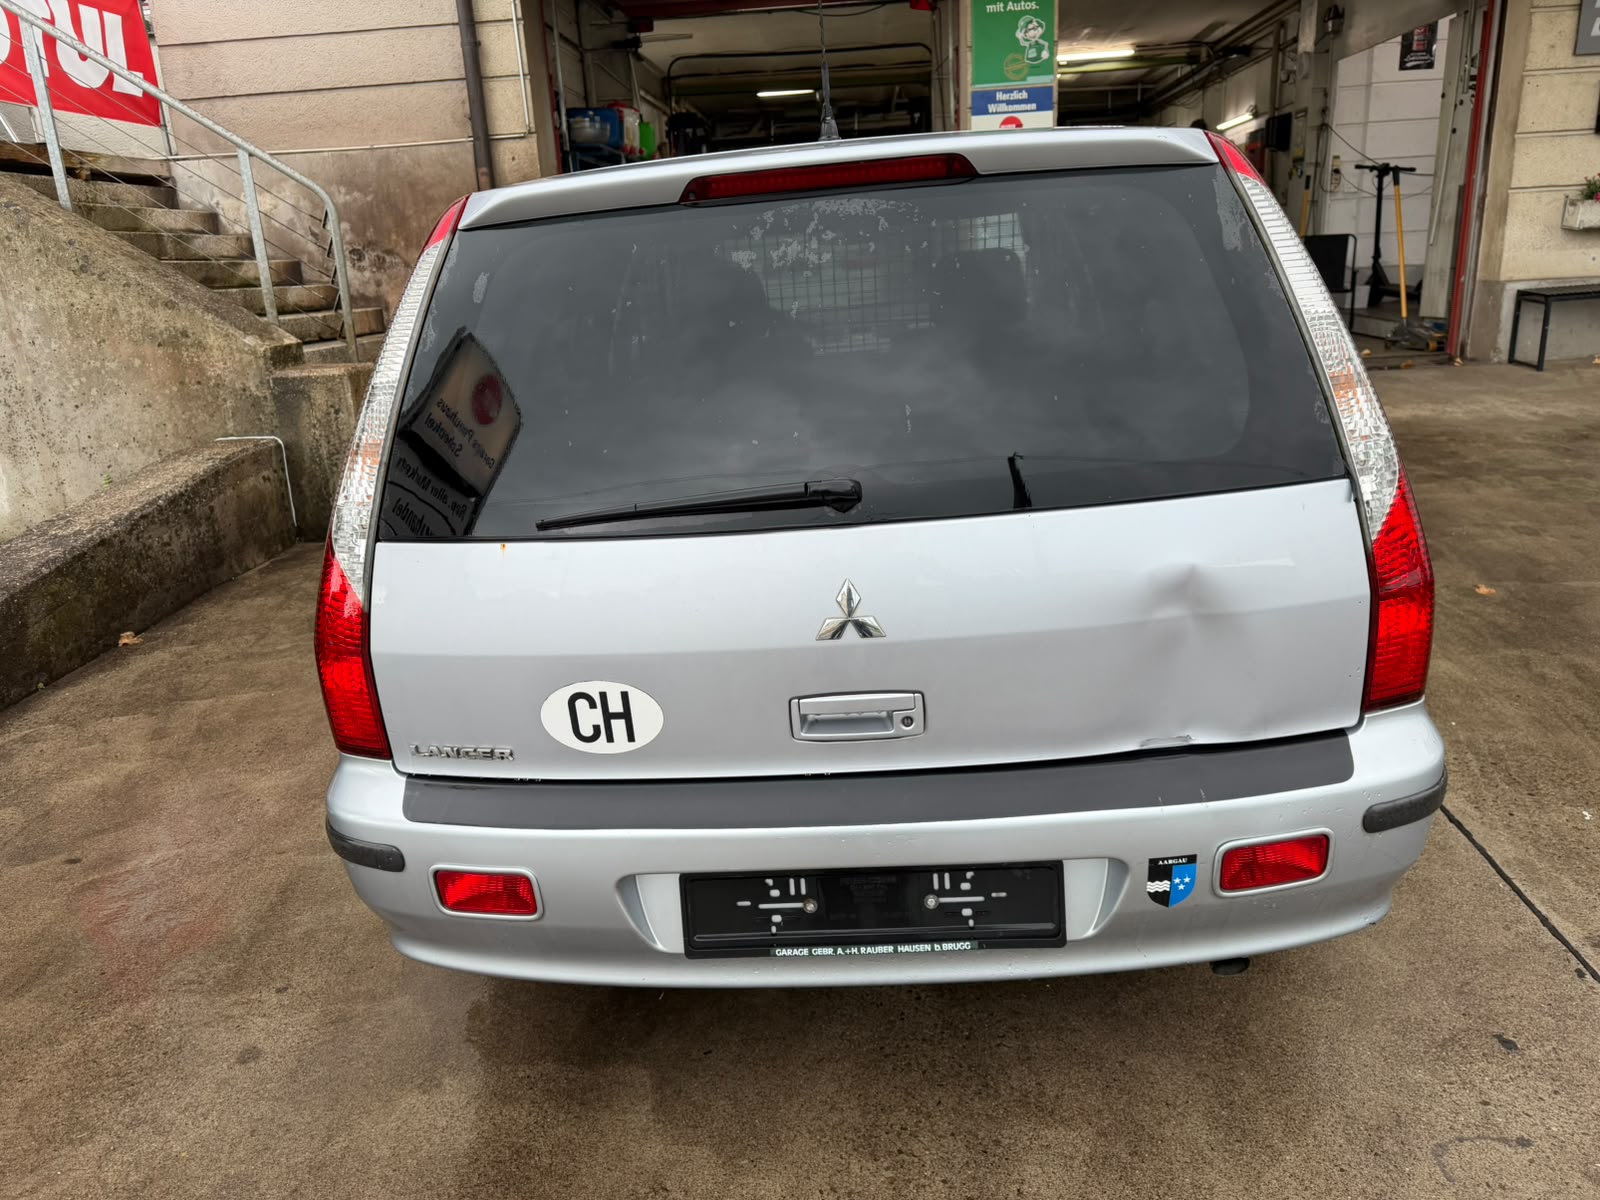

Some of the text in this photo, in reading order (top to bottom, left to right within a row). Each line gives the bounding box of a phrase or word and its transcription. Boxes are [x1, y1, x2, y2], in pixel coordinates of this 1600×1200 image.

[986, 1, 1039, 13] mit Autos.
[0, 0, 143, 97] TUL
[996, 90, 1028, 101] Herzlich
[988, 103, 1037, 113] Willkommen
[567, 691, 637, 743] CH
[409, 744, 515, 761] LANCER
[1158, 857, 1188, 866] AARGAU
[775, 948, 809, 956] GARAGE
[811, 947, 836, 956] GEBR.
[897, 943, 932, 953] HAUSEN
